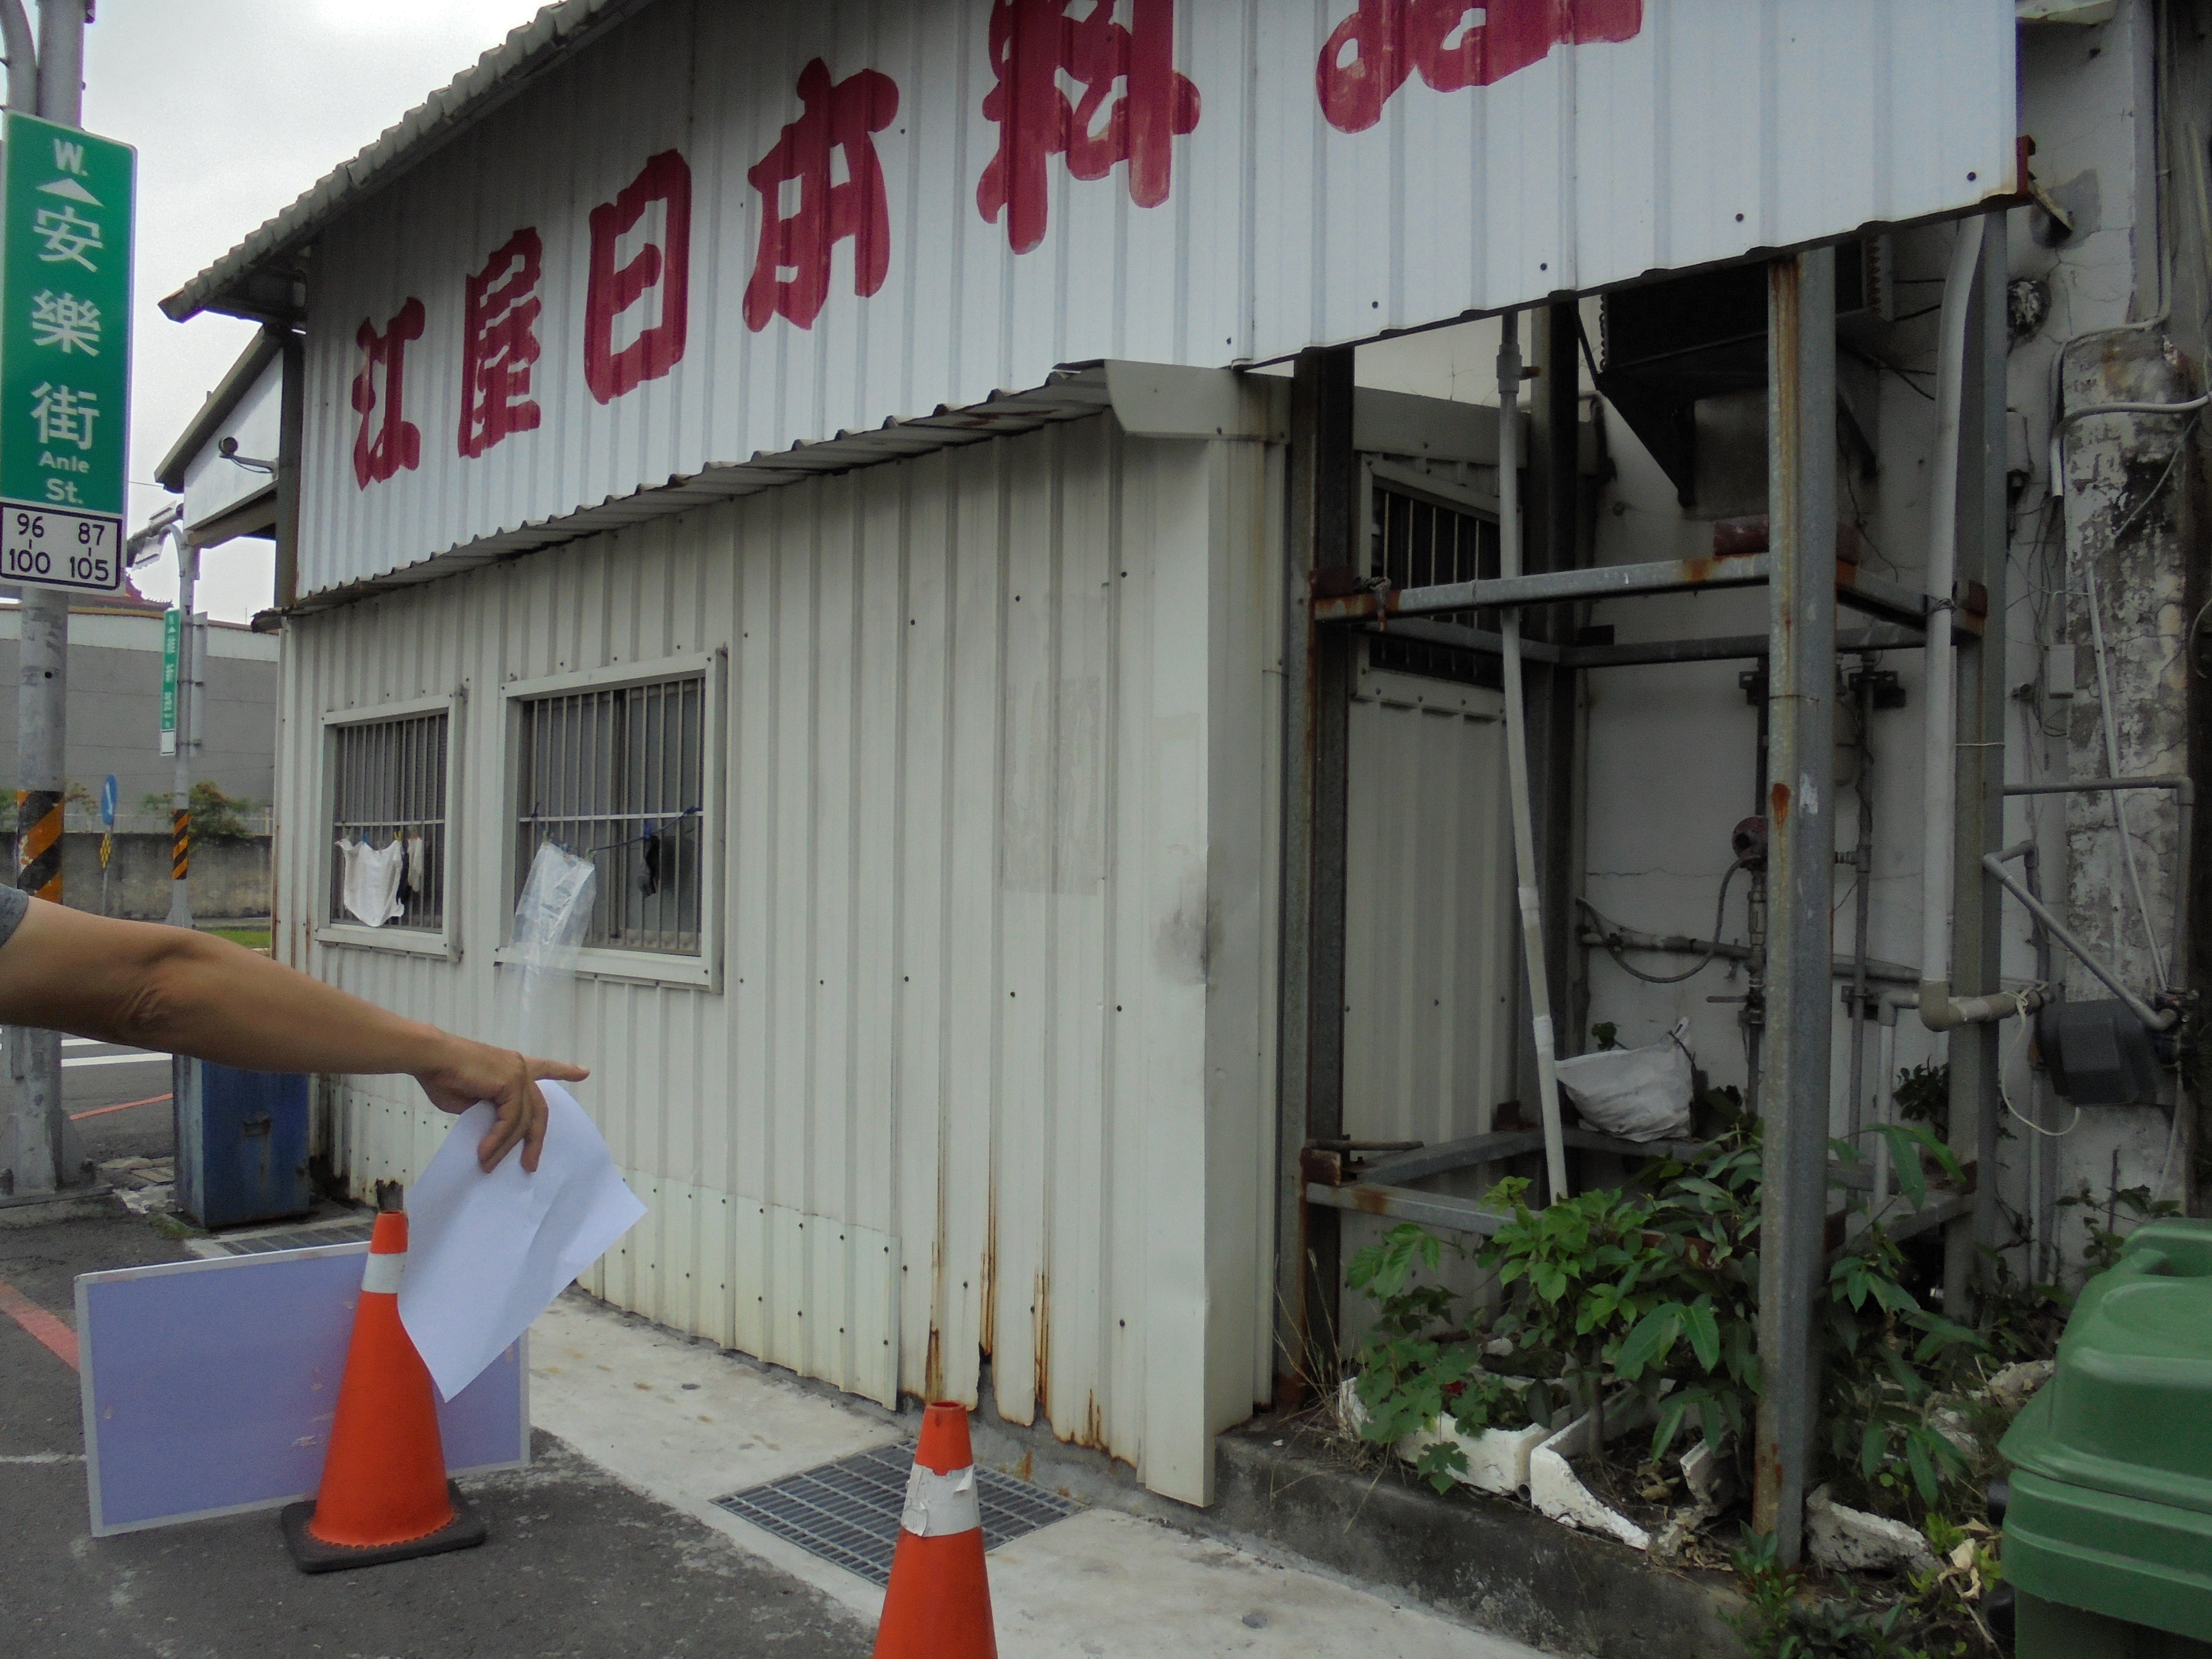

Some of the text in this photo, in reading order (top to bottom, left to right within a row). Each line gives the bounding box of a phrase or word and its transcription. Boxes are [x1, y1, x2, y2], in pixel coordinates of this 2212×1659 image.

[53, 138, 88, 177] W.
[31, 206, 104, 451] 安樂街
[38, 450, 90, 474] Anle
[45, 477, 83, 505] St.
[17, 513, 105, 546] 96 87
[9, 548, 109, 581] 100 105
